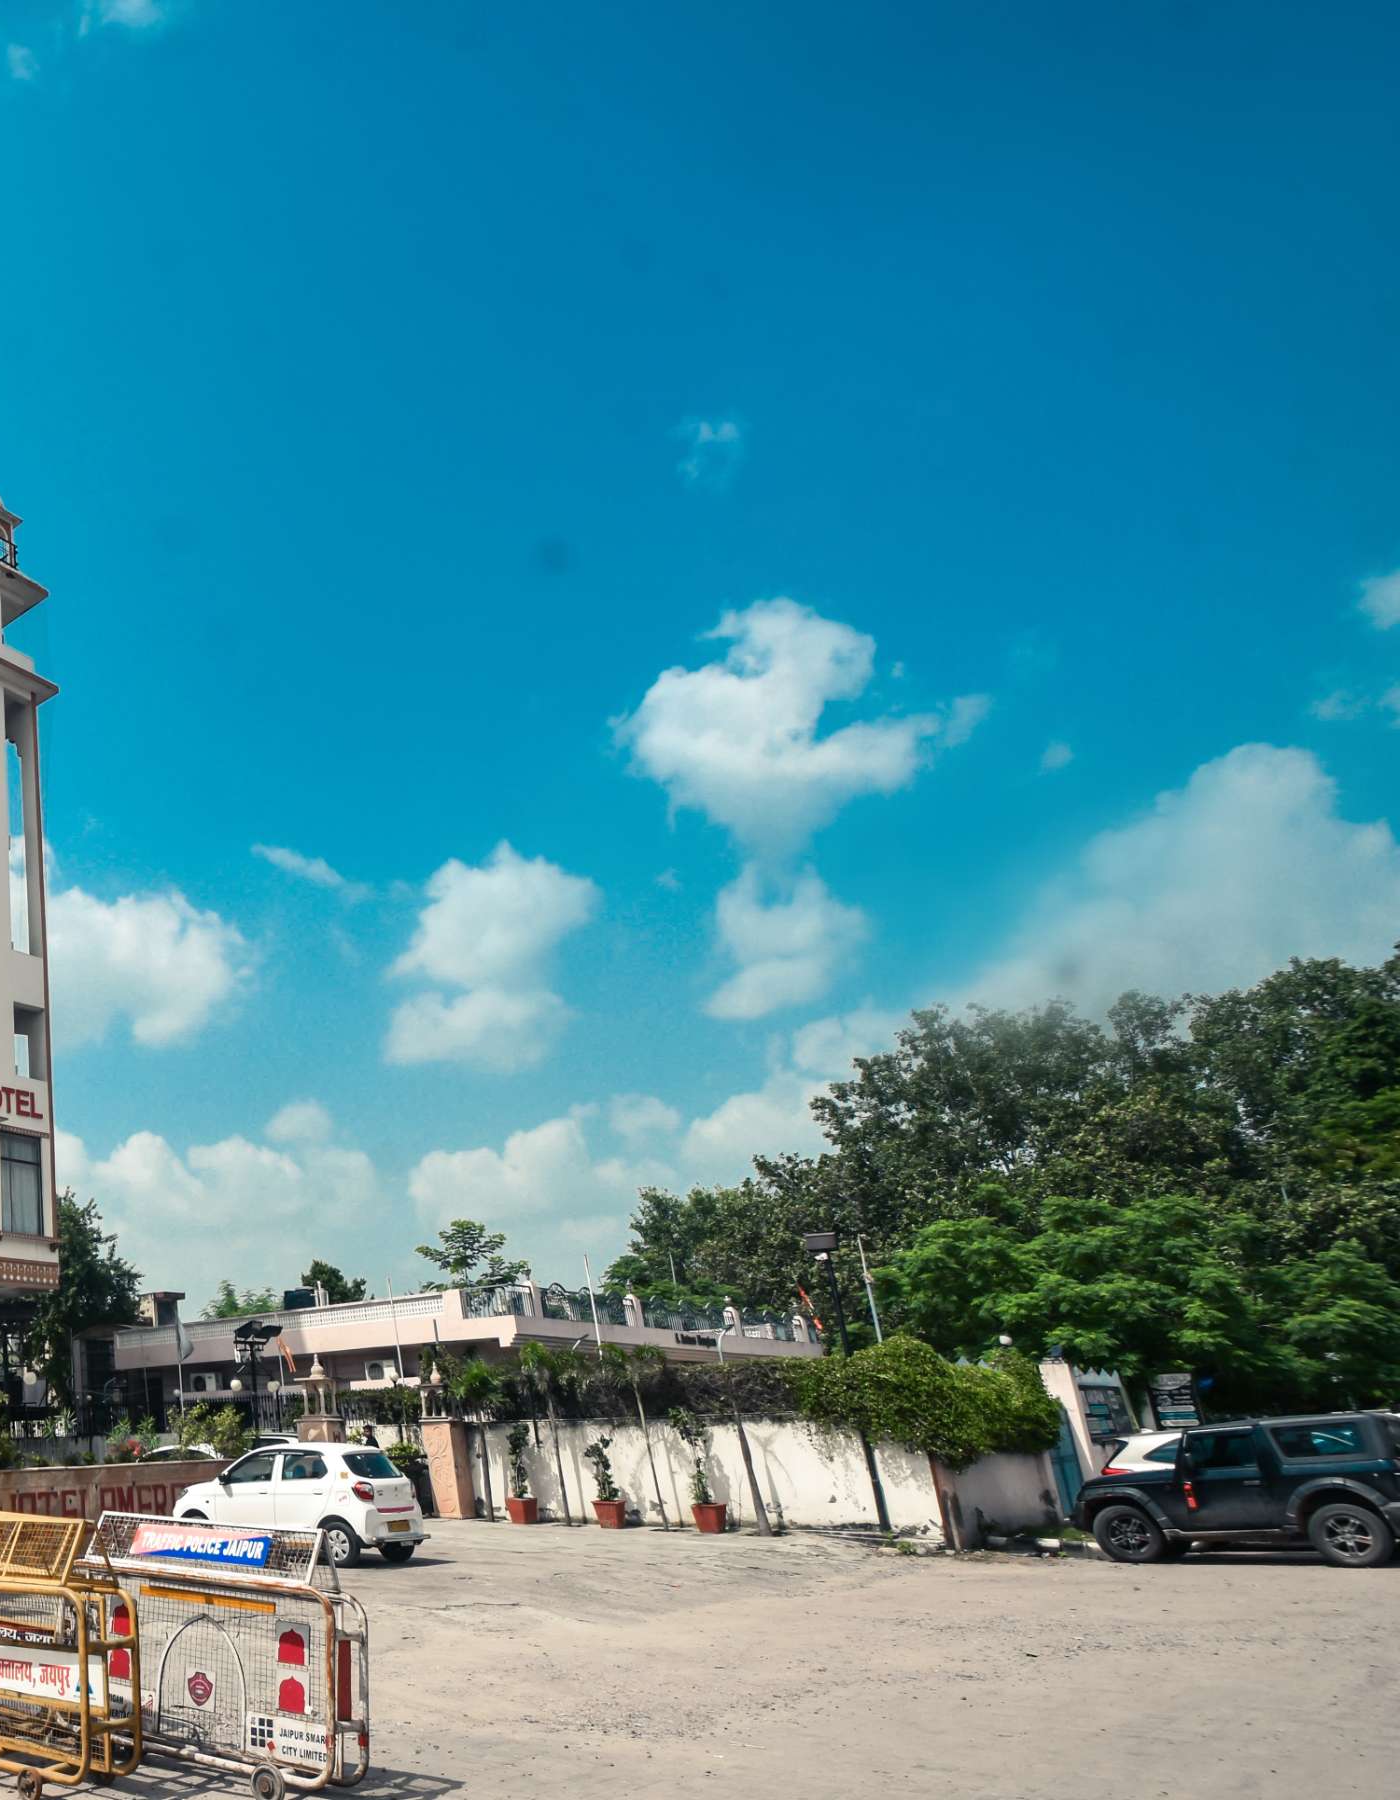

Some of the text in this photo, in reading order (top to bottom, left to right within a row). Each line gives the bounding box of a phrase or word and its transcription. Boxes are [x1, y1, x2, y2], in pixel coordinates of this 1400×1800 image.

[141, 1531, 265, 1560] TRAFFIC POLICE JAIPUR
[38, 1663, 71, 1696] जयपुर
[279, 1728, 327, 1744] JAIPUR SMAR
[281, 1745, 327, 1762] CITY LIMITED
